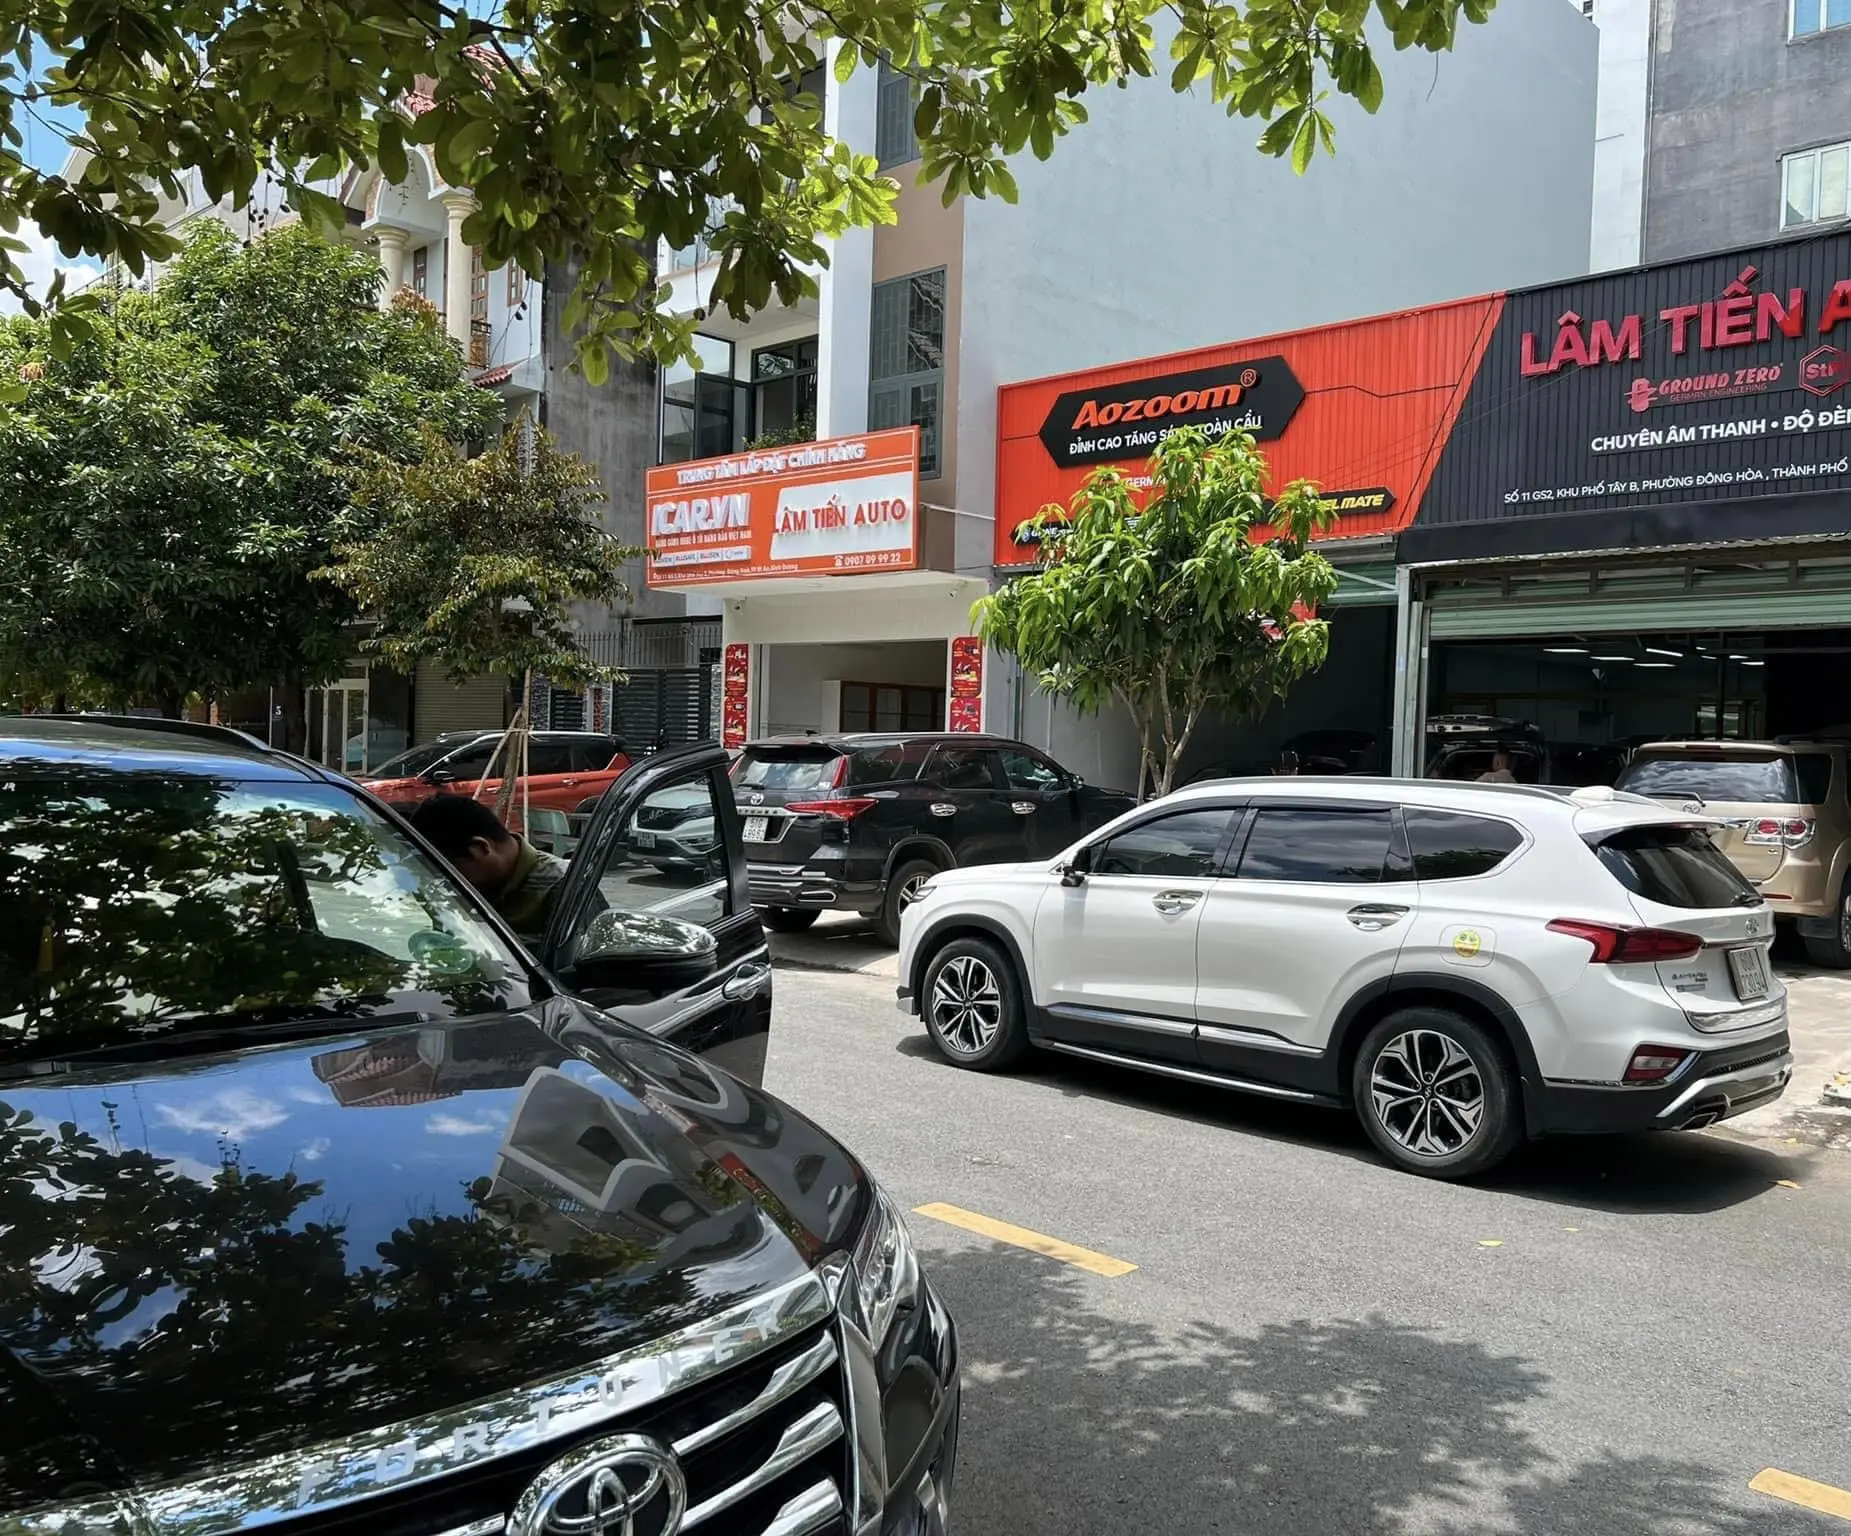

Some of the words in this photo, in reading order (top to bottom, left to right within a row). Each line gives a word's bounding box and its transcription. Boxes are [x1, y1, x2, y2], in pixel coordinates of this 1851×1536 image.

[1521, 310, 1644, 377] LÂM
[1659, 265, 1805, 353] TIẾN
[1658, 372, 1730, 396] GROUND
[1734, 366, 1782, 386] ZERO
[1709, 383, 1768, 397] ENGINEERING
[1069, 436, 1096, 455] ĐỈNH
[1097, 436, 1122, 450] CAO
[1126, 430, 1157, 447] TĂNG
[1234, 409, 1262, 430] CẦU
[1591, 427, 1663, 452] CHUYÊN
[1665, 424, 1696, 443] ÂM
[1699, 418, 1767, 440] THANH
[1783, 410, 1815, 433] ĐỘ
[1504, 488, 1519, 503] SỐ
[1521, 492, 1530, 501] 11
[1556, 487, 1579, 498] KHU
[1581, 480, 1605, 496] PHỐ
[1607, 481, 1627, 493] TÂY
[1642, 475, 1694, 491] PHƯỜNG
[1697, 472, 1733, 486] ĐÔNG
[1772, 463, 1816, 479] THÀNH
[1820, 456, 1849, 473] PHỐ
[812, 493, 847, 530] TIẾN
[854, 498, 907, 525] AUTO
[844, 555, 864, 566] 0907
[865, 555, 876, 564] 09
[878, 553, 889, 563] 99
[890, 551, 901, 562] 22
[298, 1303, 783, 1503] FORTUNER
